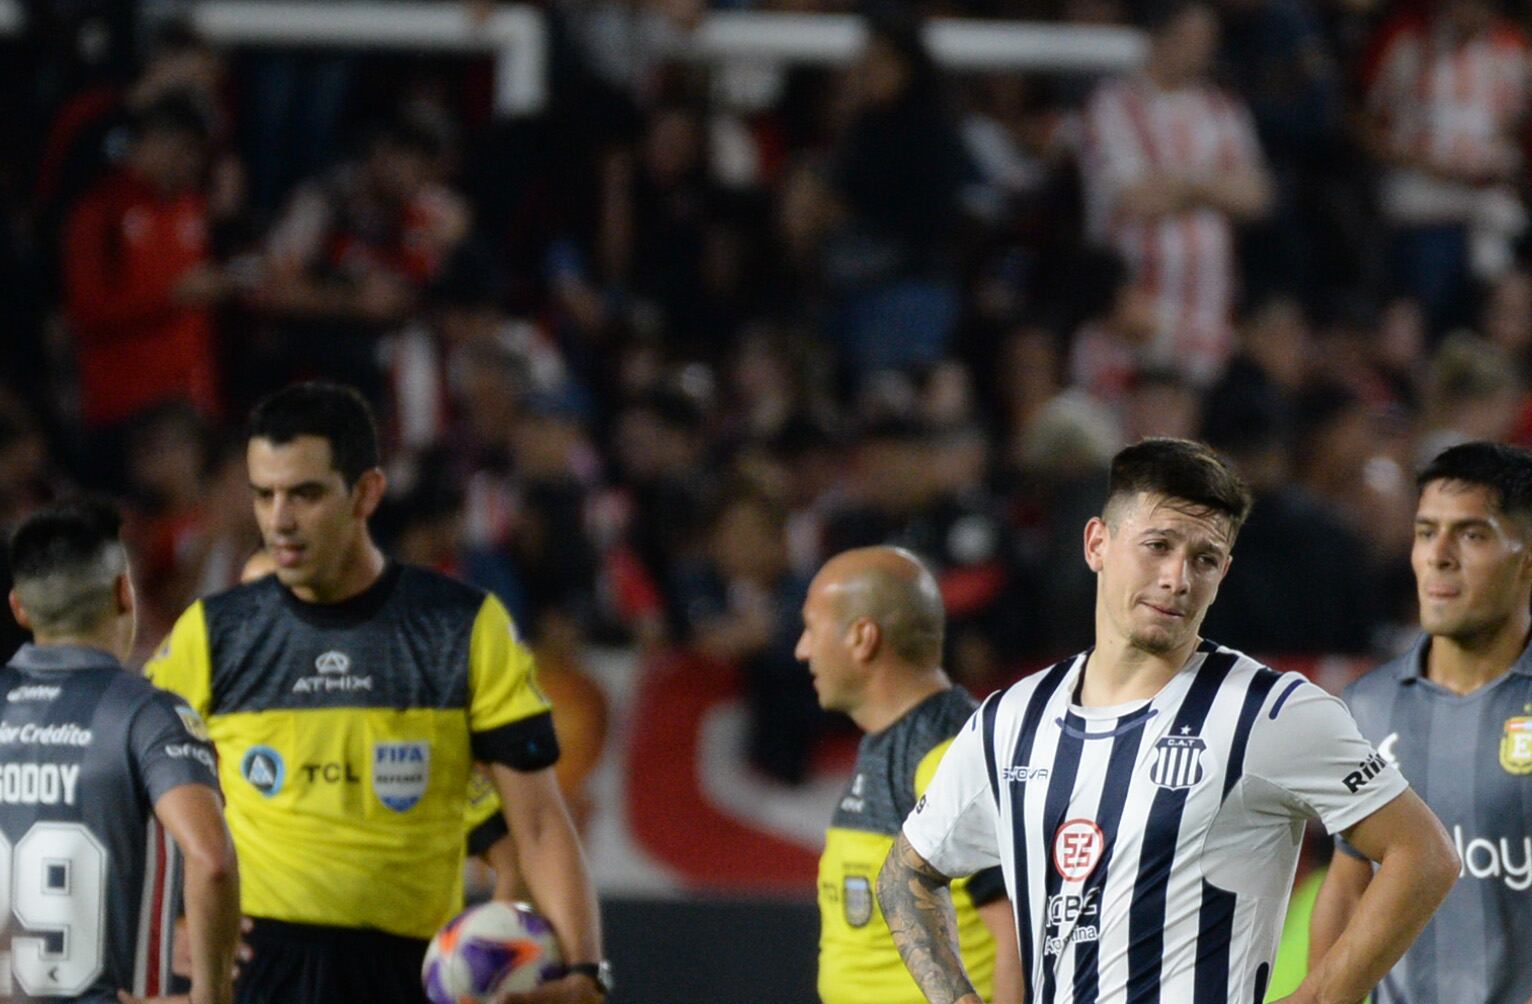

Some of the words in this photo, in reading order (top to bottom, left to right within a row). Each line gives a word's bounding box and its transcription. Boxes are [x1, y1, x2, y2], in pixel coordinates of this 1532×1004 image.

[292, 675, 374, 694] ATHIX
[376, 745, 423, 762] FIFA
[302, 763, 361, 784] TCL
[0, 762, 81, 806] ODOY
